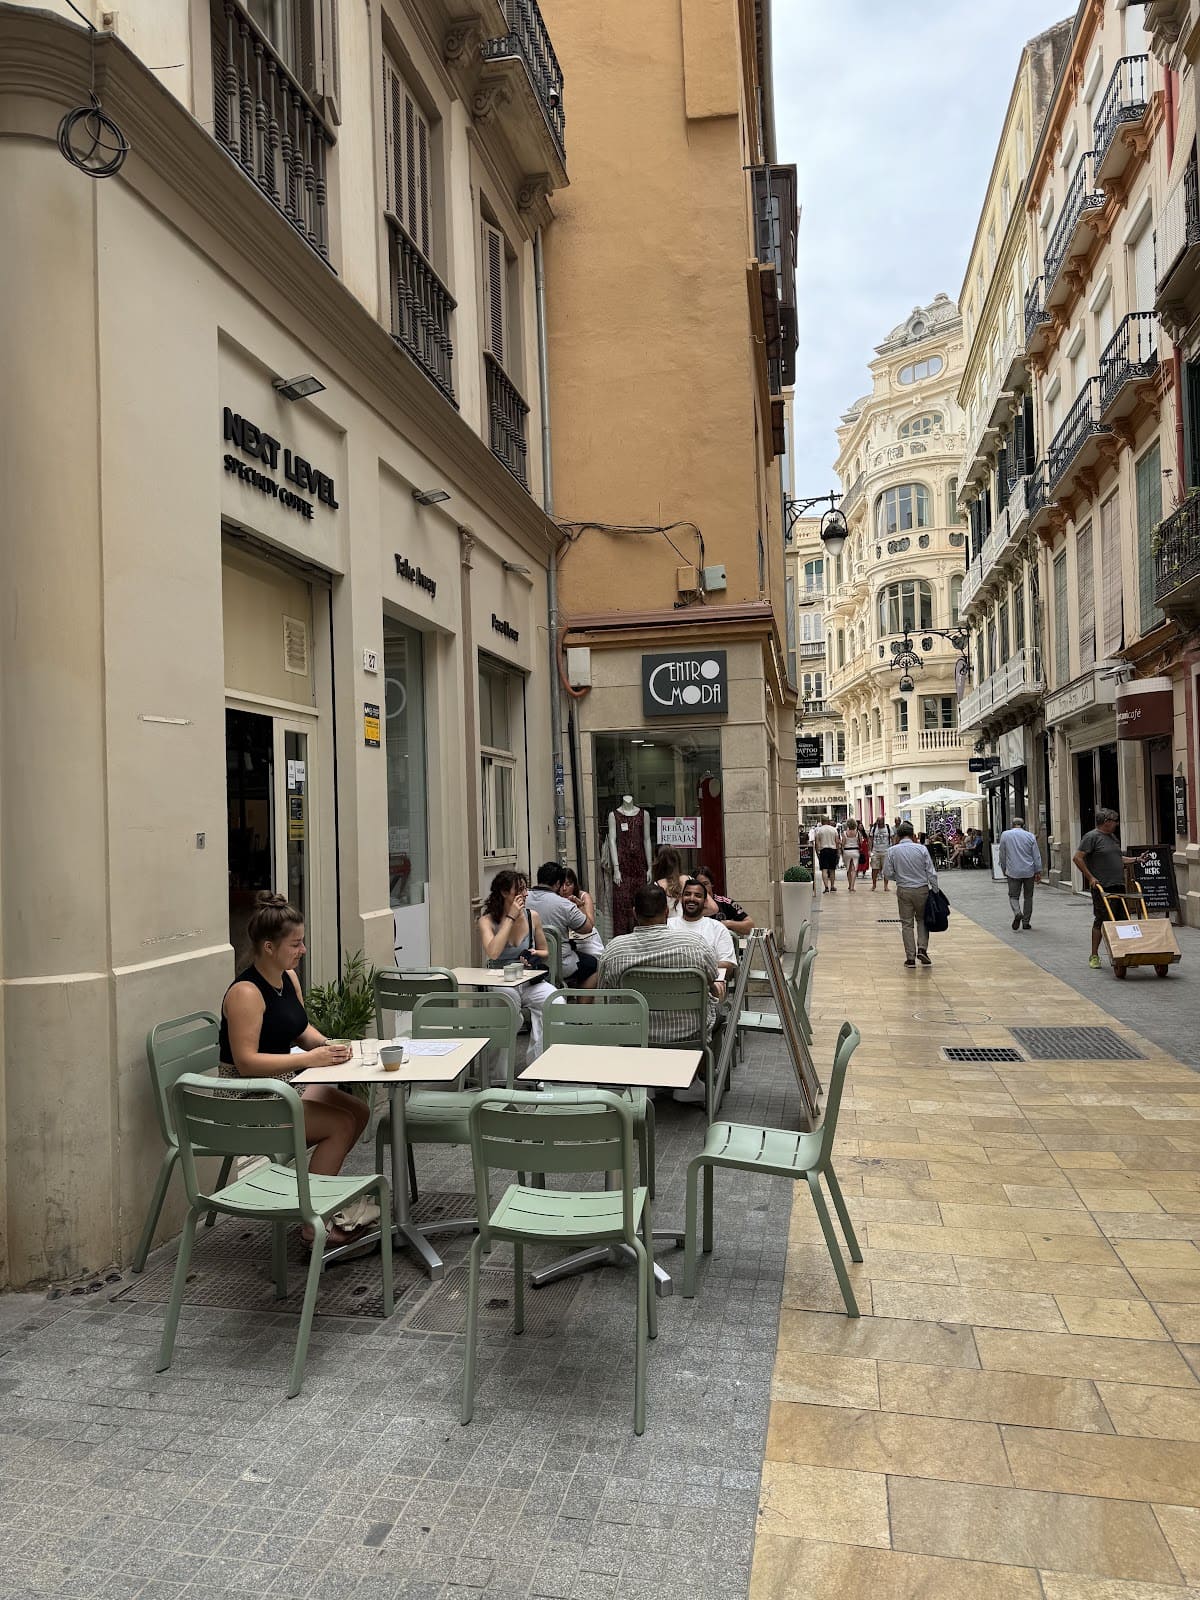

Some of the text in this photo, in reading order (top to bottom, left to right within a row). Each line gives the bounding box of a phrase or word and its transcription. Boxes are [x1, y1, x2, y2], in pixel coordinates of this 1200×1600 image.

[223, 407, 339, 509] NEXT LEVEL
[279, 488, 314, 519] COFFEE
[394, 553, 436, 598] Take Away
[649, 660, 720, 705] CENTRO
[671, 683, 721, 705] MODA
[661, 834, 697, 843] REBAJAS
[662, 824, 696, 832] REBAJAS
